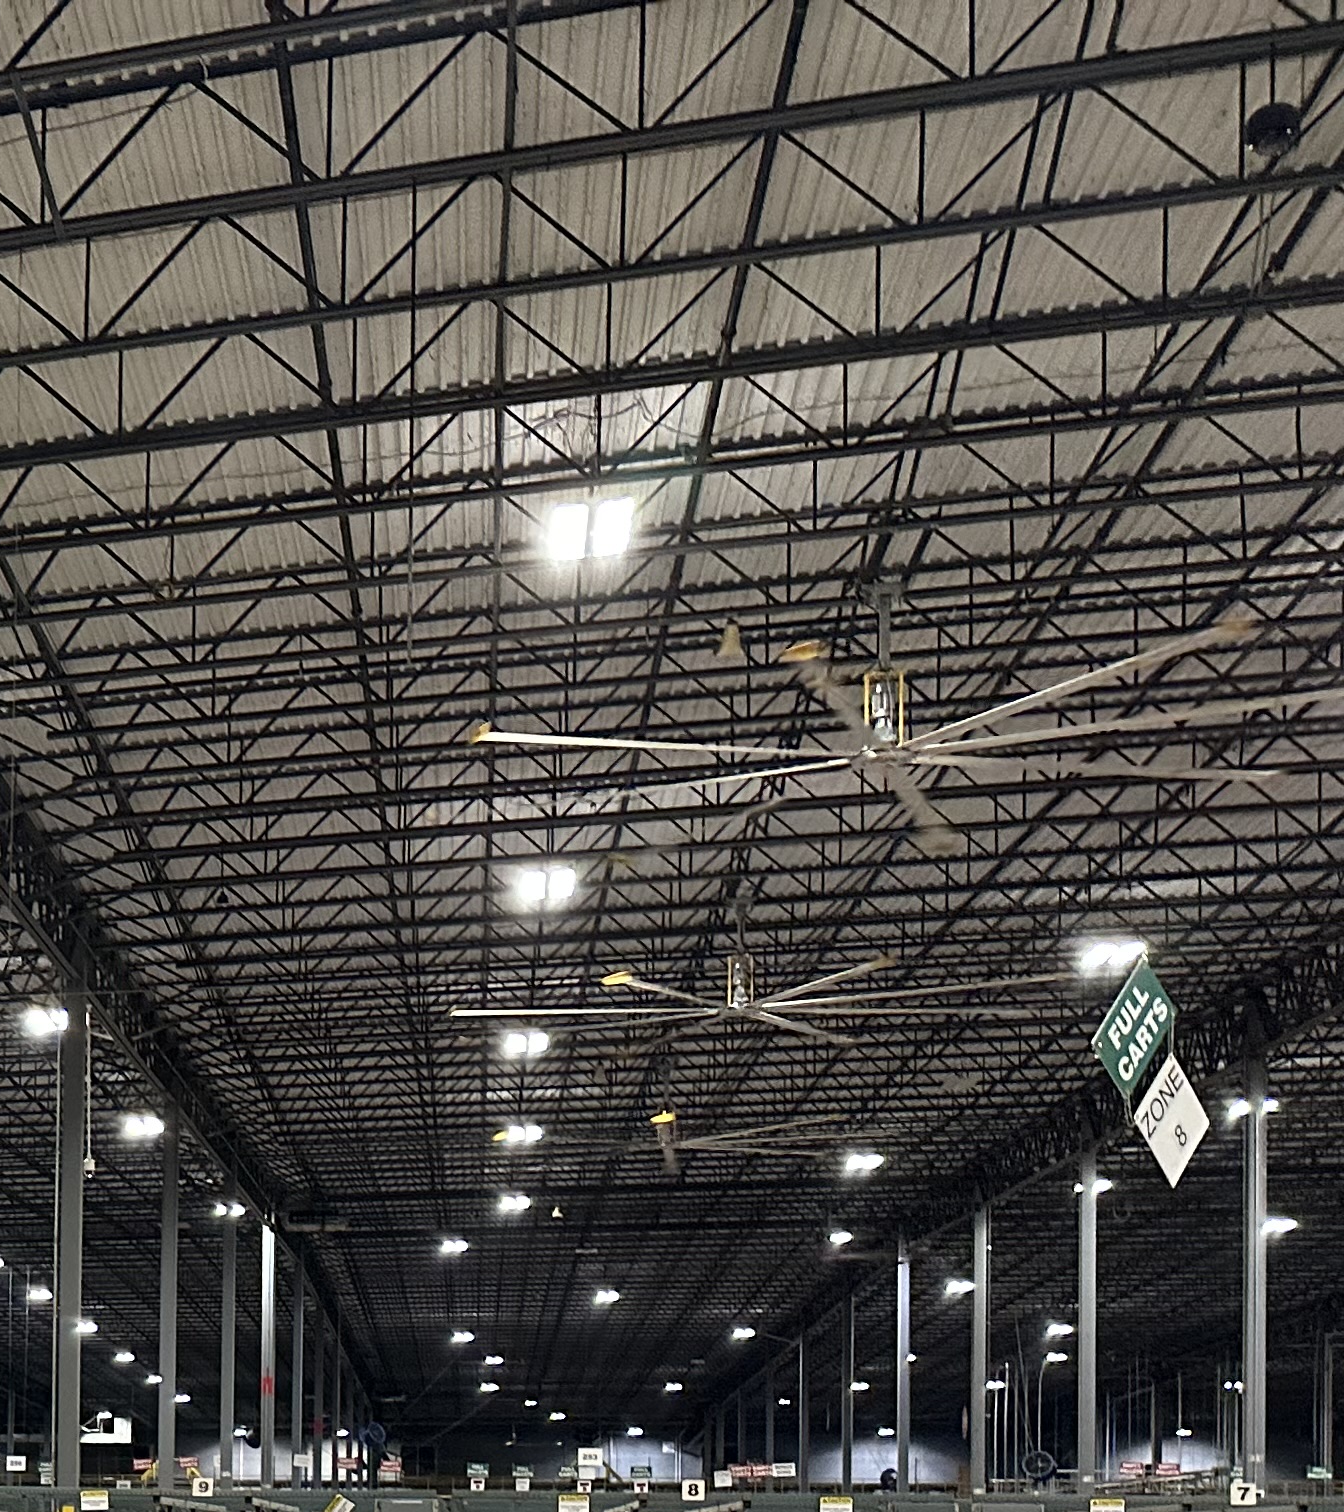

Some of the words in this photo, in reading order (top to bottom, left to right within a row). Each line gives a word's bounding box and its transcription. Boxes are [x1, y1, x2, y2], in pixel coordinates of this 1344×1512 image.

[1107, 985, 1150, 1050] FULL
[1118, 997, 1168, 1081] CARTS
[1140, 1064, 1185, 1139] ZONE
[1174, 1124, 1188, 1147] 8
[198, 1481, 209, 1493] 9
[688, 1484, 699, 1496] 8
[1237, 1487, 1251, 1501] 7
